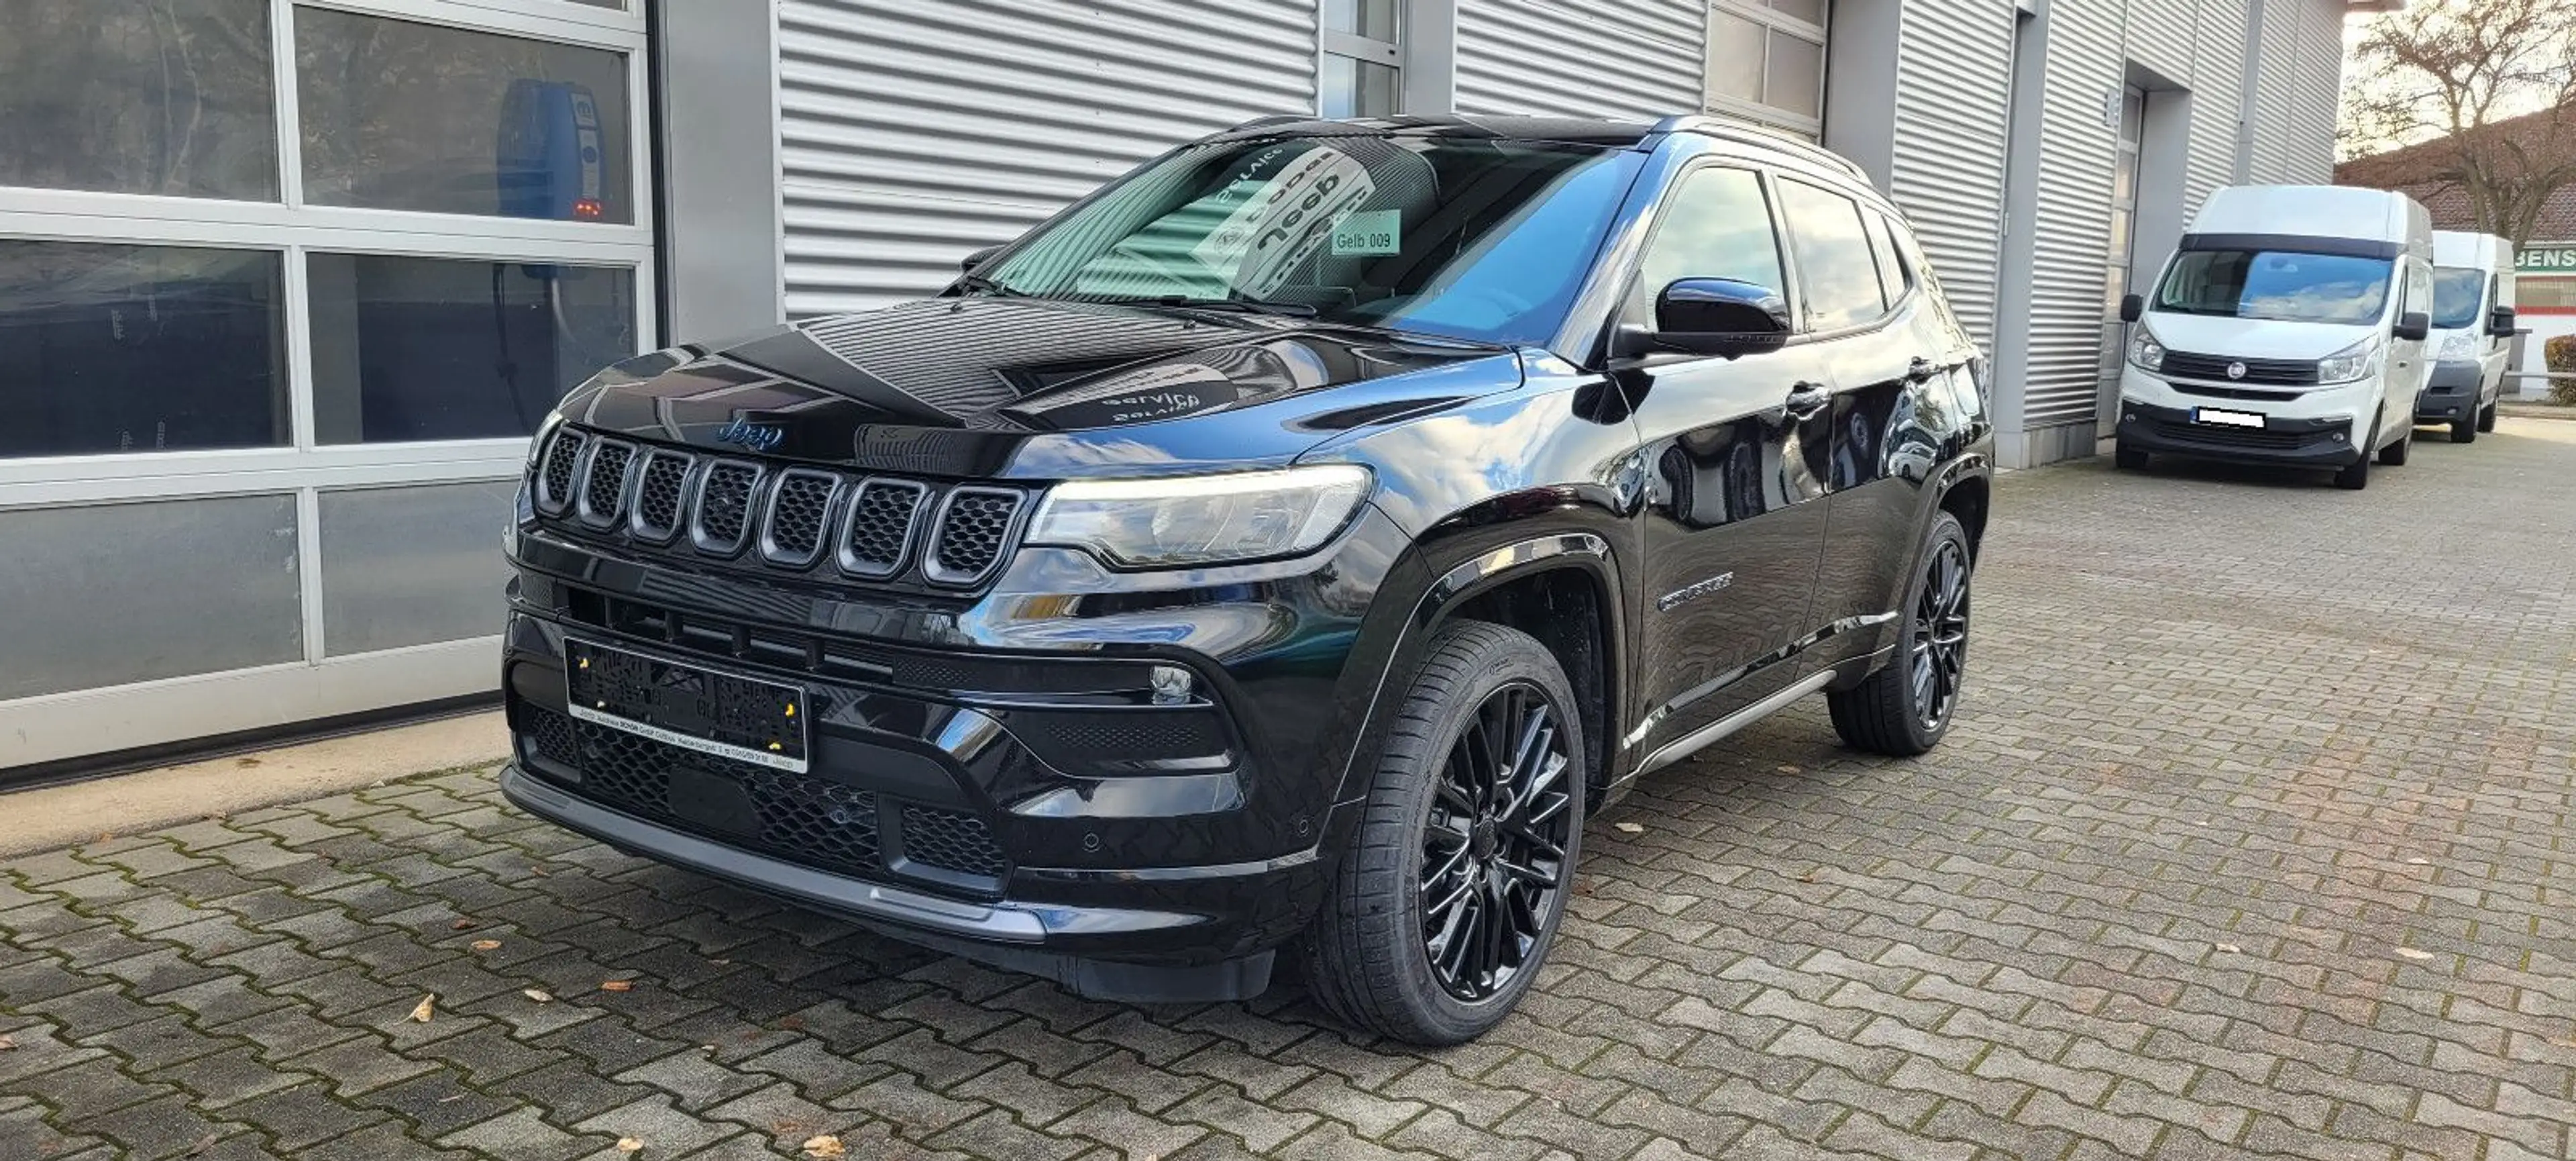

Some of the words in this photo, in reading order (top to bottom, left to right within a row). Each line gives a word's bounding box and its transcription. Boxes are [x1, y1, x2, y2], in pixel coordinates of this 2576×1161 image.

[1336, 234, 1365, 248] Gelb
[1370, 234, 1391, 248] 009
[718, 417, 783, 450] Jeep
